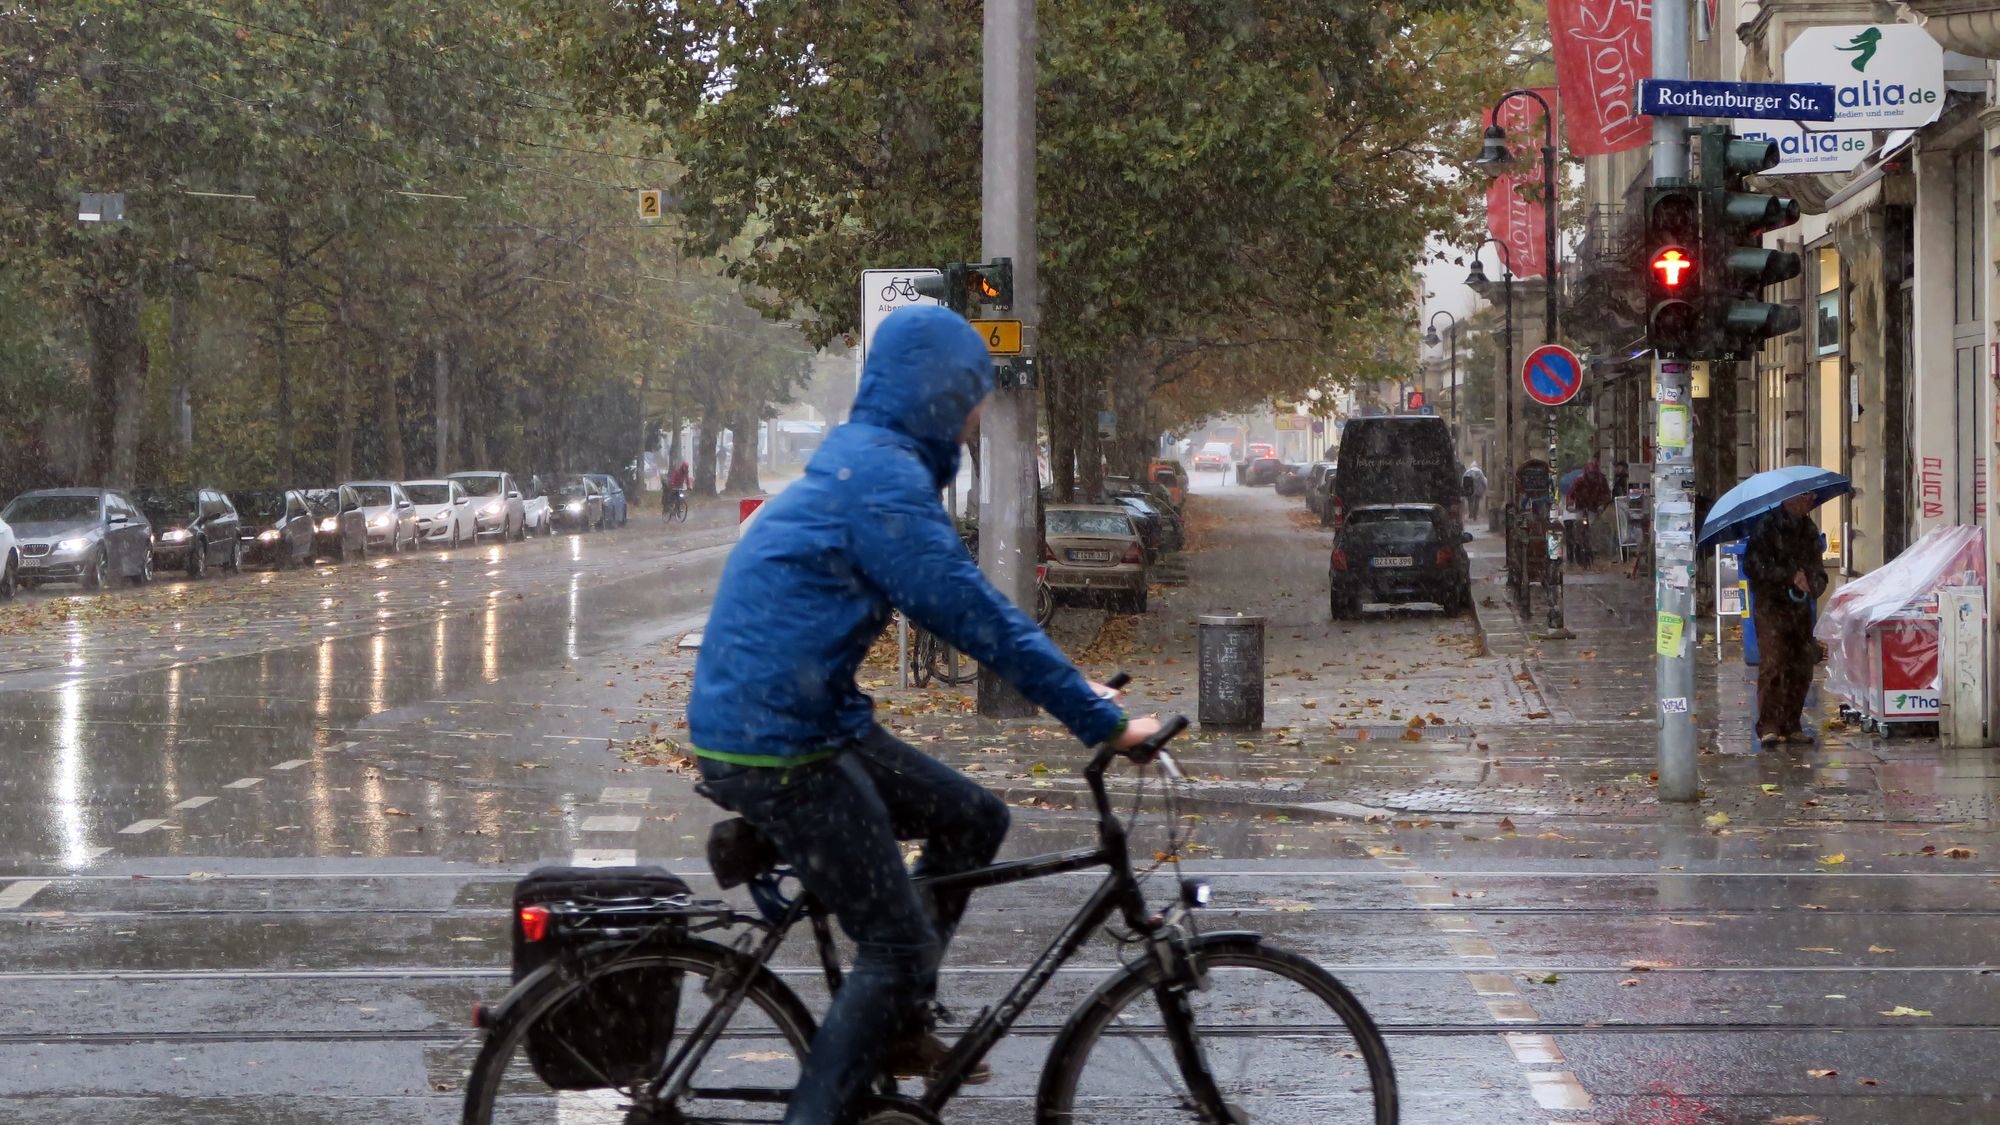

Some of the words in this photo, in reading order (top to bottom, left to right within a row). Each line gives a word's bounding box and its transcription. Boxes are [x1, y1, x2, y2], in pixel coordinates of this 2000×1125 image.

[1658, 87, 1782, 112] Rothenburger
[1789, 92, 1819, 110] Str.
[1866, 109, 1882, 117] und
[1883, 108, 1905, 116] mehr
[644, 196, 656, 213] 2
[989, 326, 1000, 347] 6
